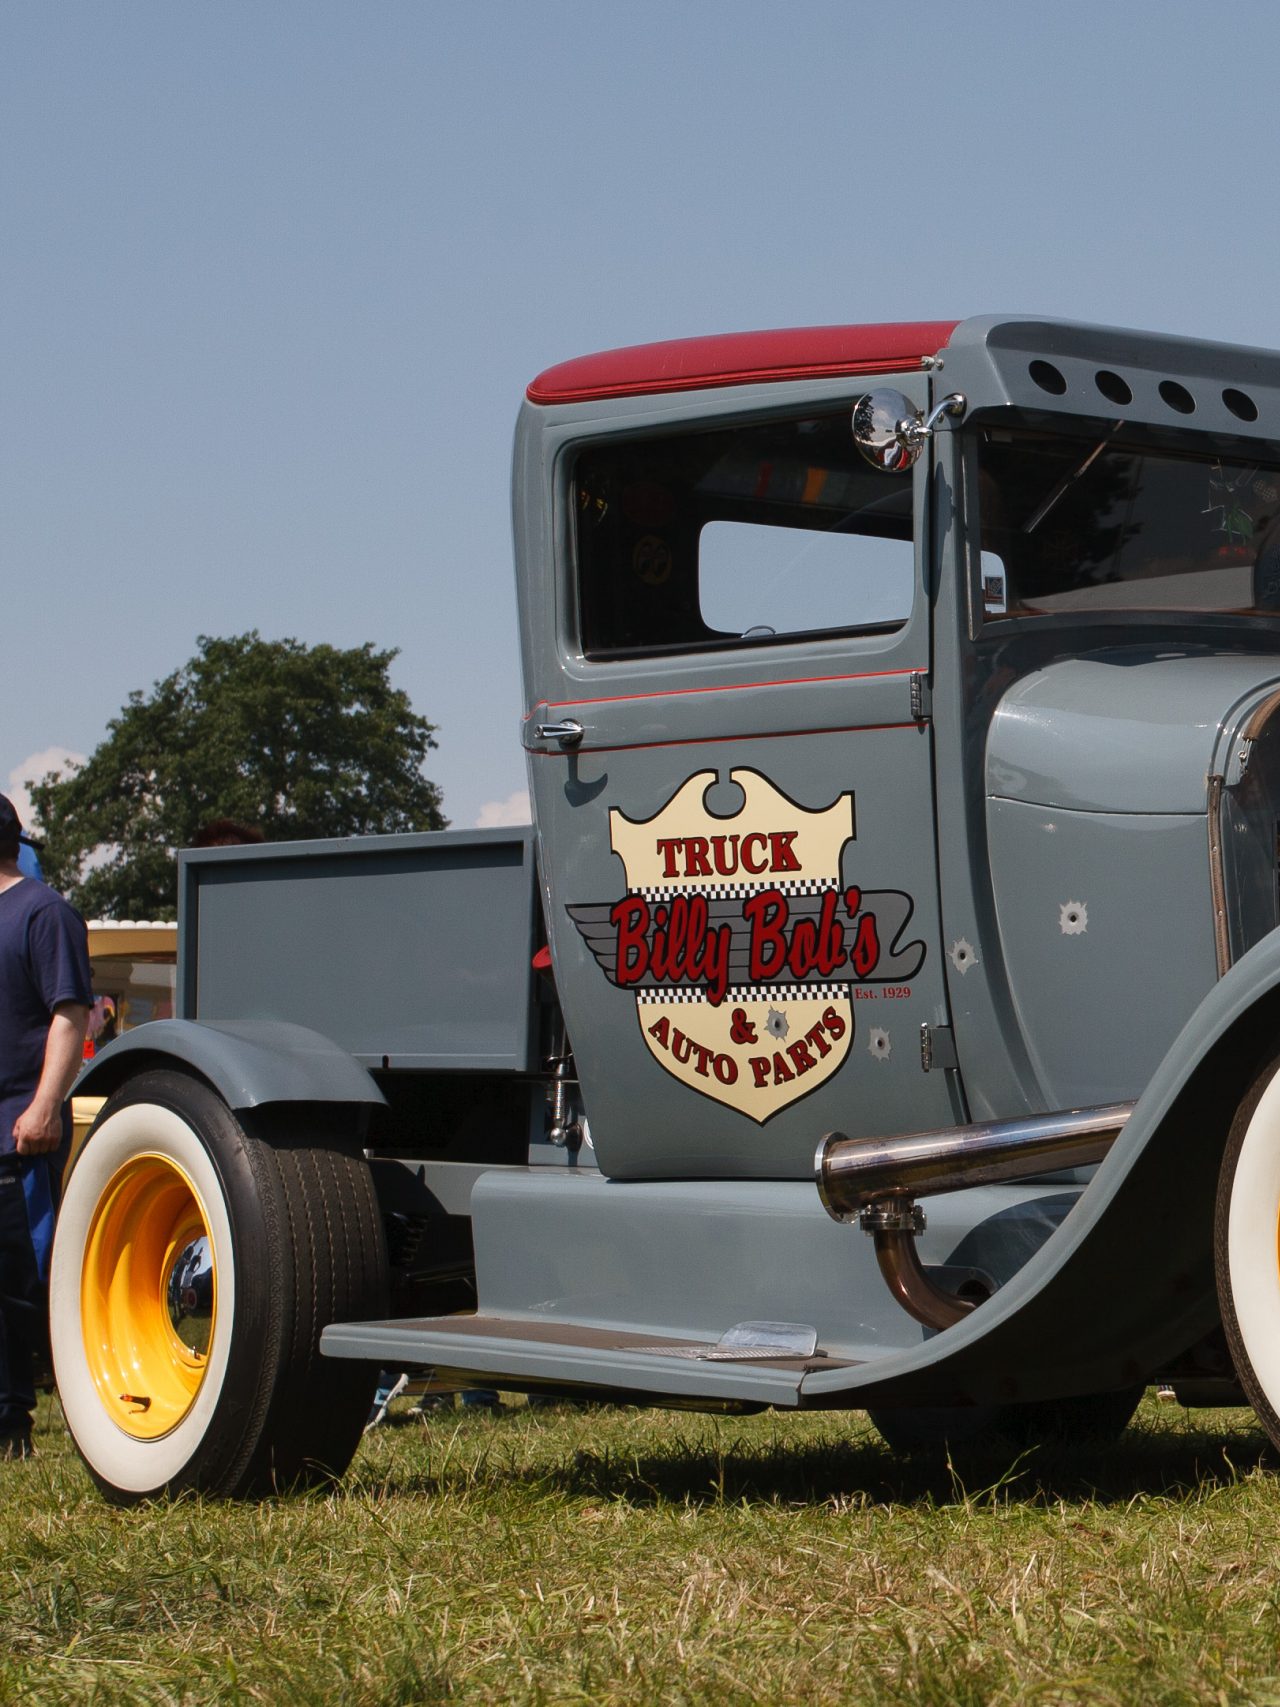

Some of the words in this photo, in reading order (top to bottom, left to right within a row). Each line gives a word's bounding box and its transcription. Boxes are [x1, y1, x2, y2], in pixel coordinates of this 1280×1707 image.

[657, 831, 802, 878] TRUCK
[610, 892, 732, 1007] Billy
[743, 885, 880, 979] Bob's
[855, 987, 878, 999] Est.
[882, 986, 912, 999] 1929
[648, 1016, 739, 1085] AUTO
[748, 1006, 846, 1088] PARTS
[729, 1007, 758, 1045] &
